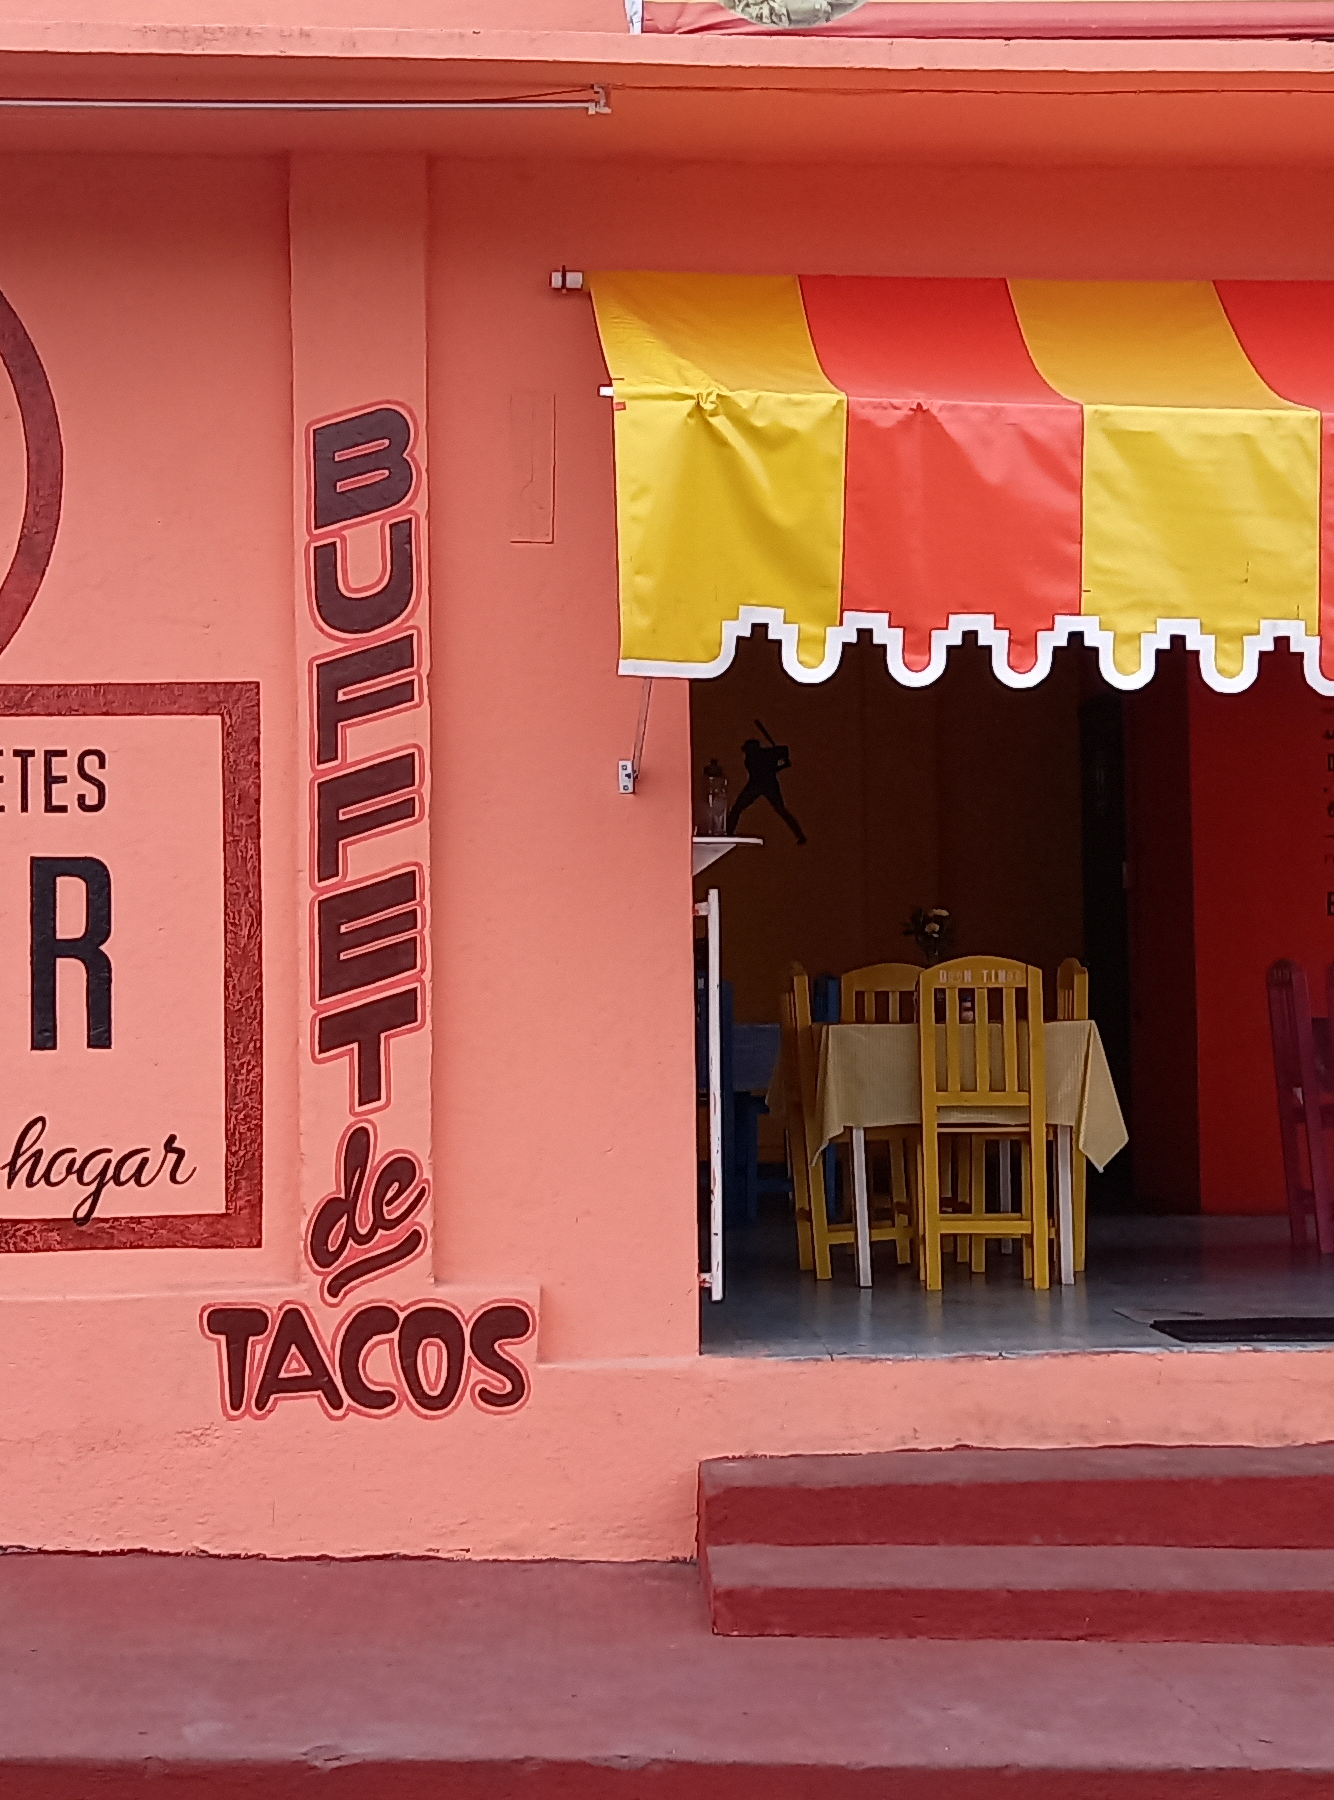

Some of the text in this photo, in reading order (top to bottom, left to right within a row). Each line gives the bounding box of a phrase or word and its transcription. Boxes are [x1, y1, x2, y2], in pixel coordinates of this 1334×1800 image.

[0, 1115, 198, 1228] hogar
[204, 405, 532, 1413] BUFFET de TACOS
